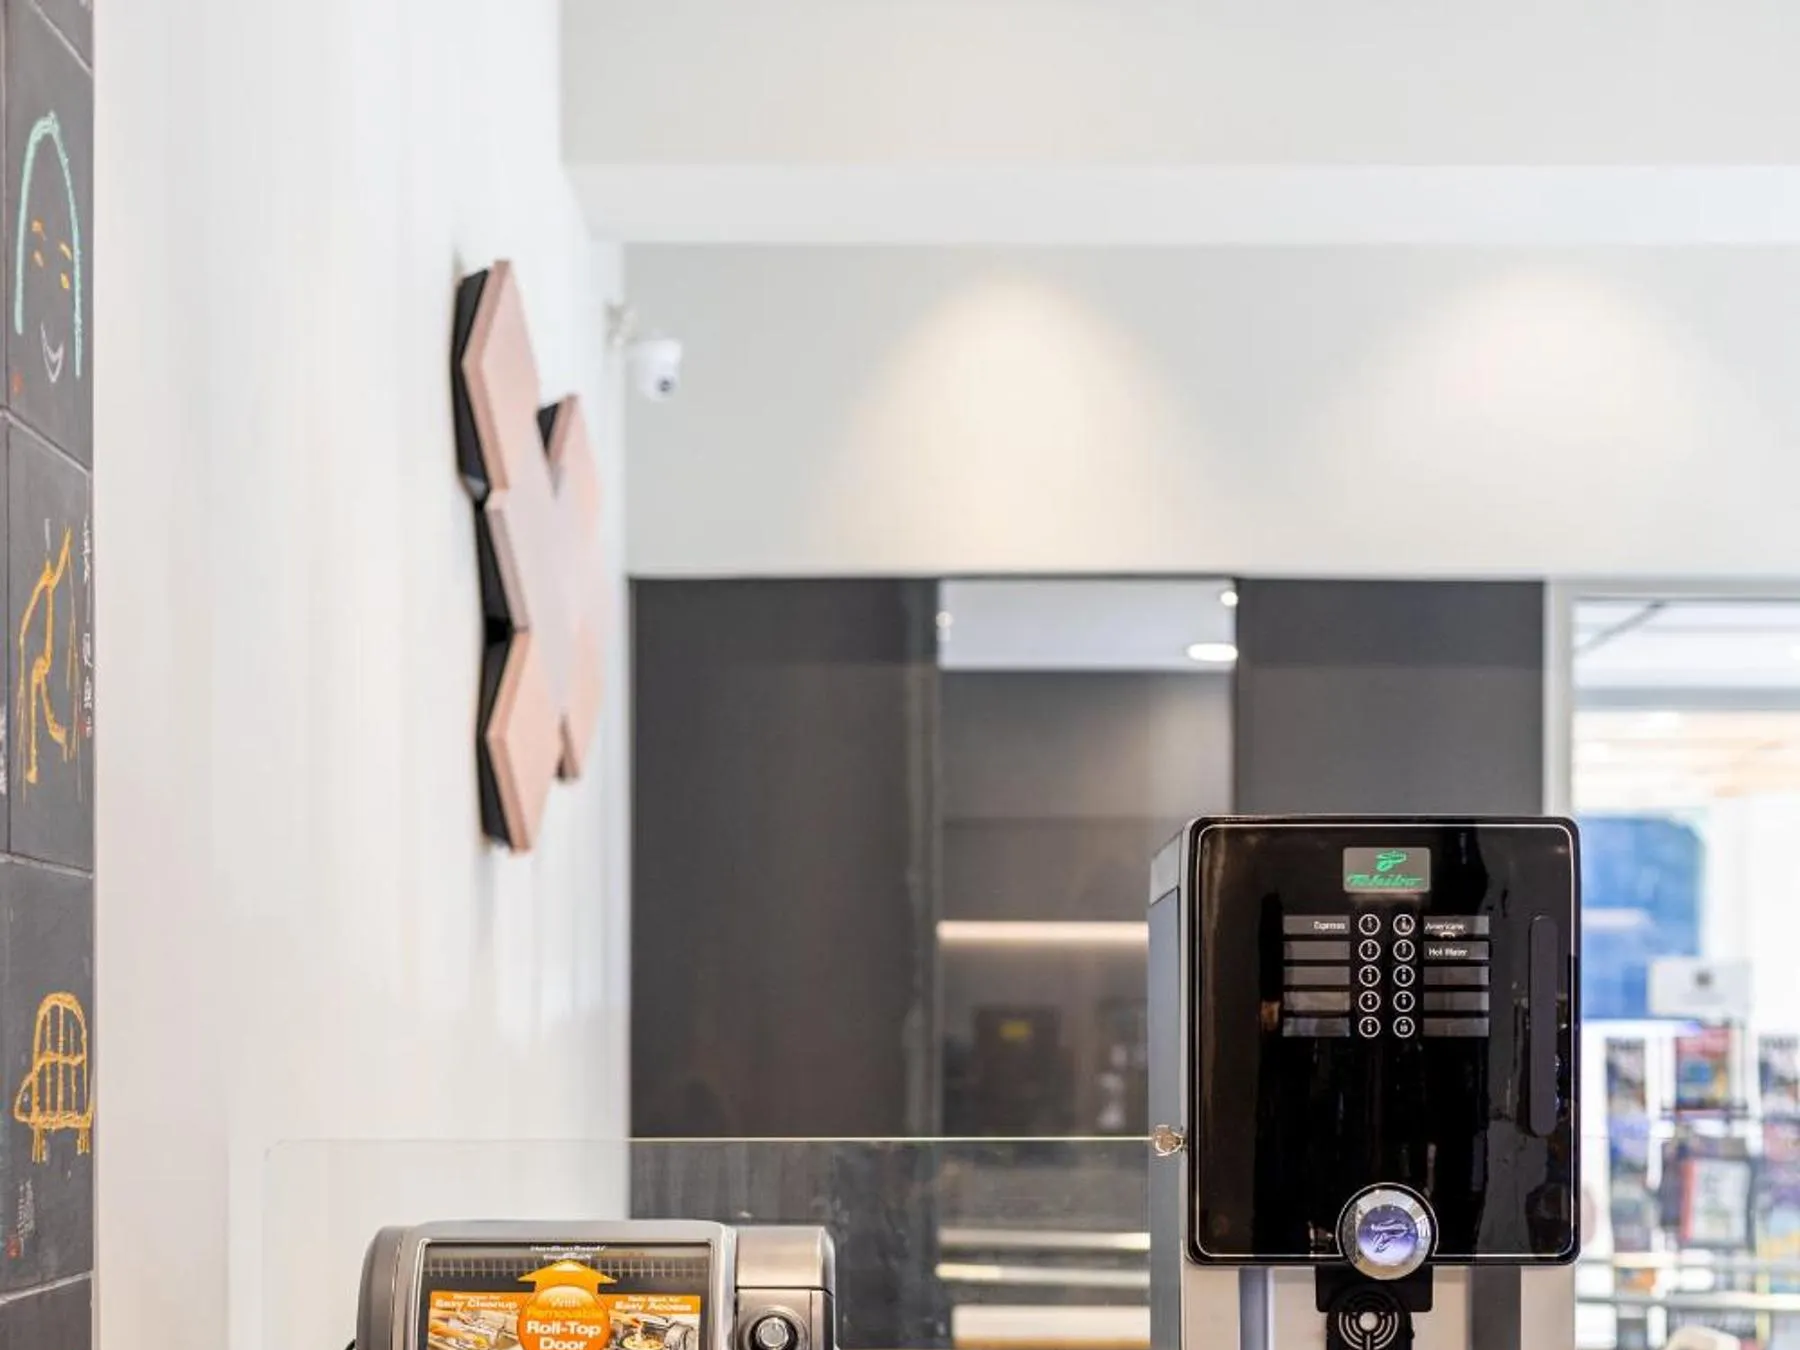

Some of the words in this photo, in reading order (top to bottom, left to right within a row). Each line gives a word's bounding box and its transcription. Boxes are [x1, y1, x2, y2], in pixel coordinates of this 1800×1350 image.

[1428, 947, 1443, 957] Hot
[526, 1320, 601, 1338] Roll-Top
[540, 1336, 587, 1350] Door
